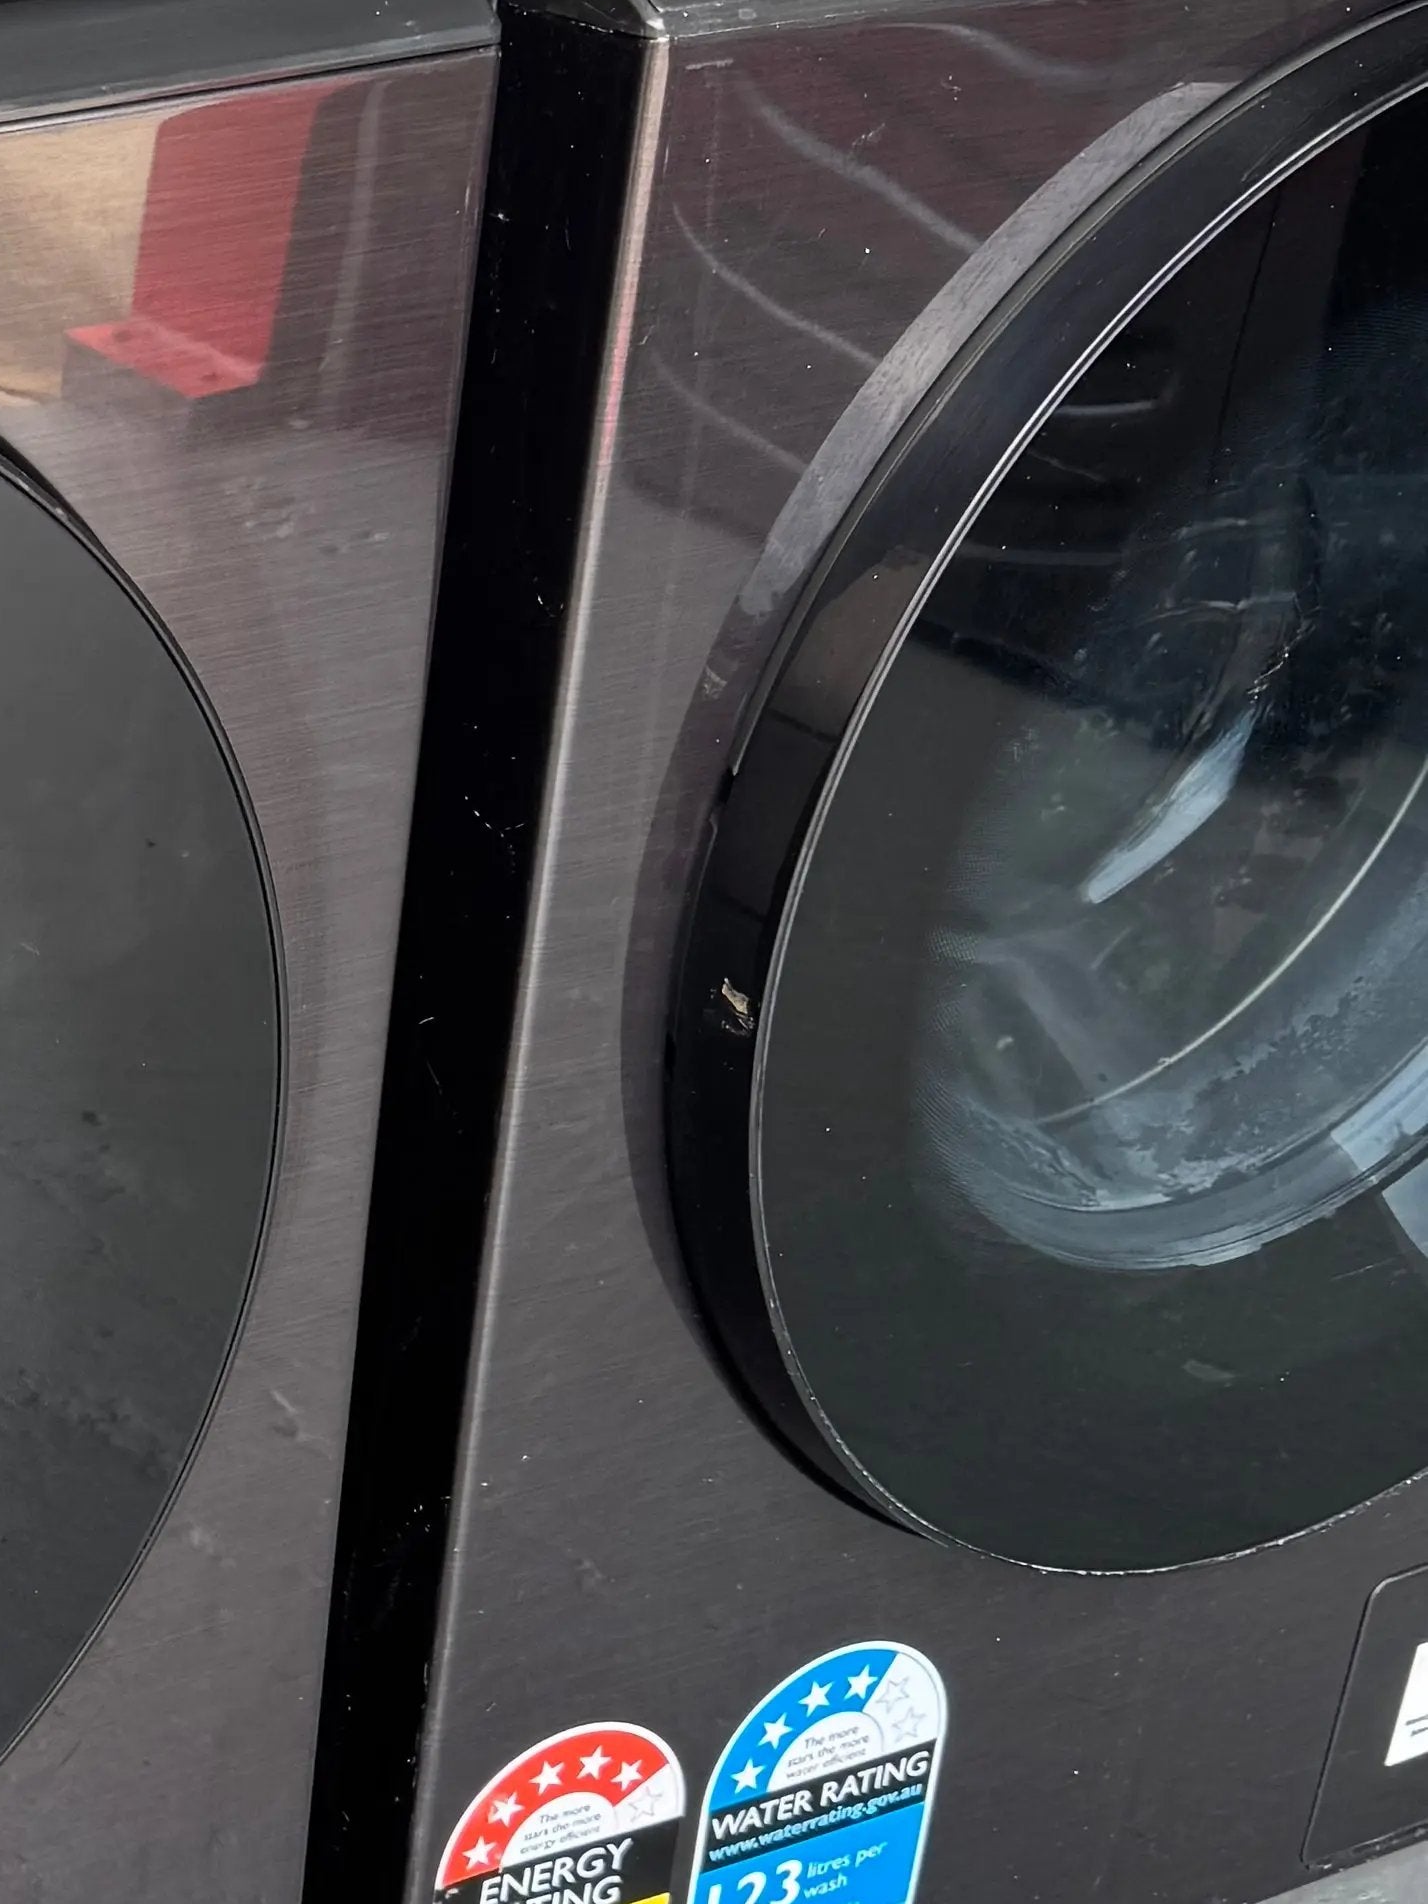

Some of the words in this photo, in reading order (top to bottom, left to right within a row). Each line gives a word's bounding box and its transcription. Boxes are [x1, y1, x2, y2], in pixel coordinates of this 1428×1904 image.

[804, 1736, 826, 1749] The
[828, 1726, 860, 1742] more
[711, 1791, 813, 1841] WATER
[820, 1750, 930, 1807] RATING
[709, 1783, 922, 1862] www.waterrating.gov.au
[807, 1853, 850, 1879] litres
[855, 1841, 888, 1867] per
[804, 1873, 847, 1899] wash
